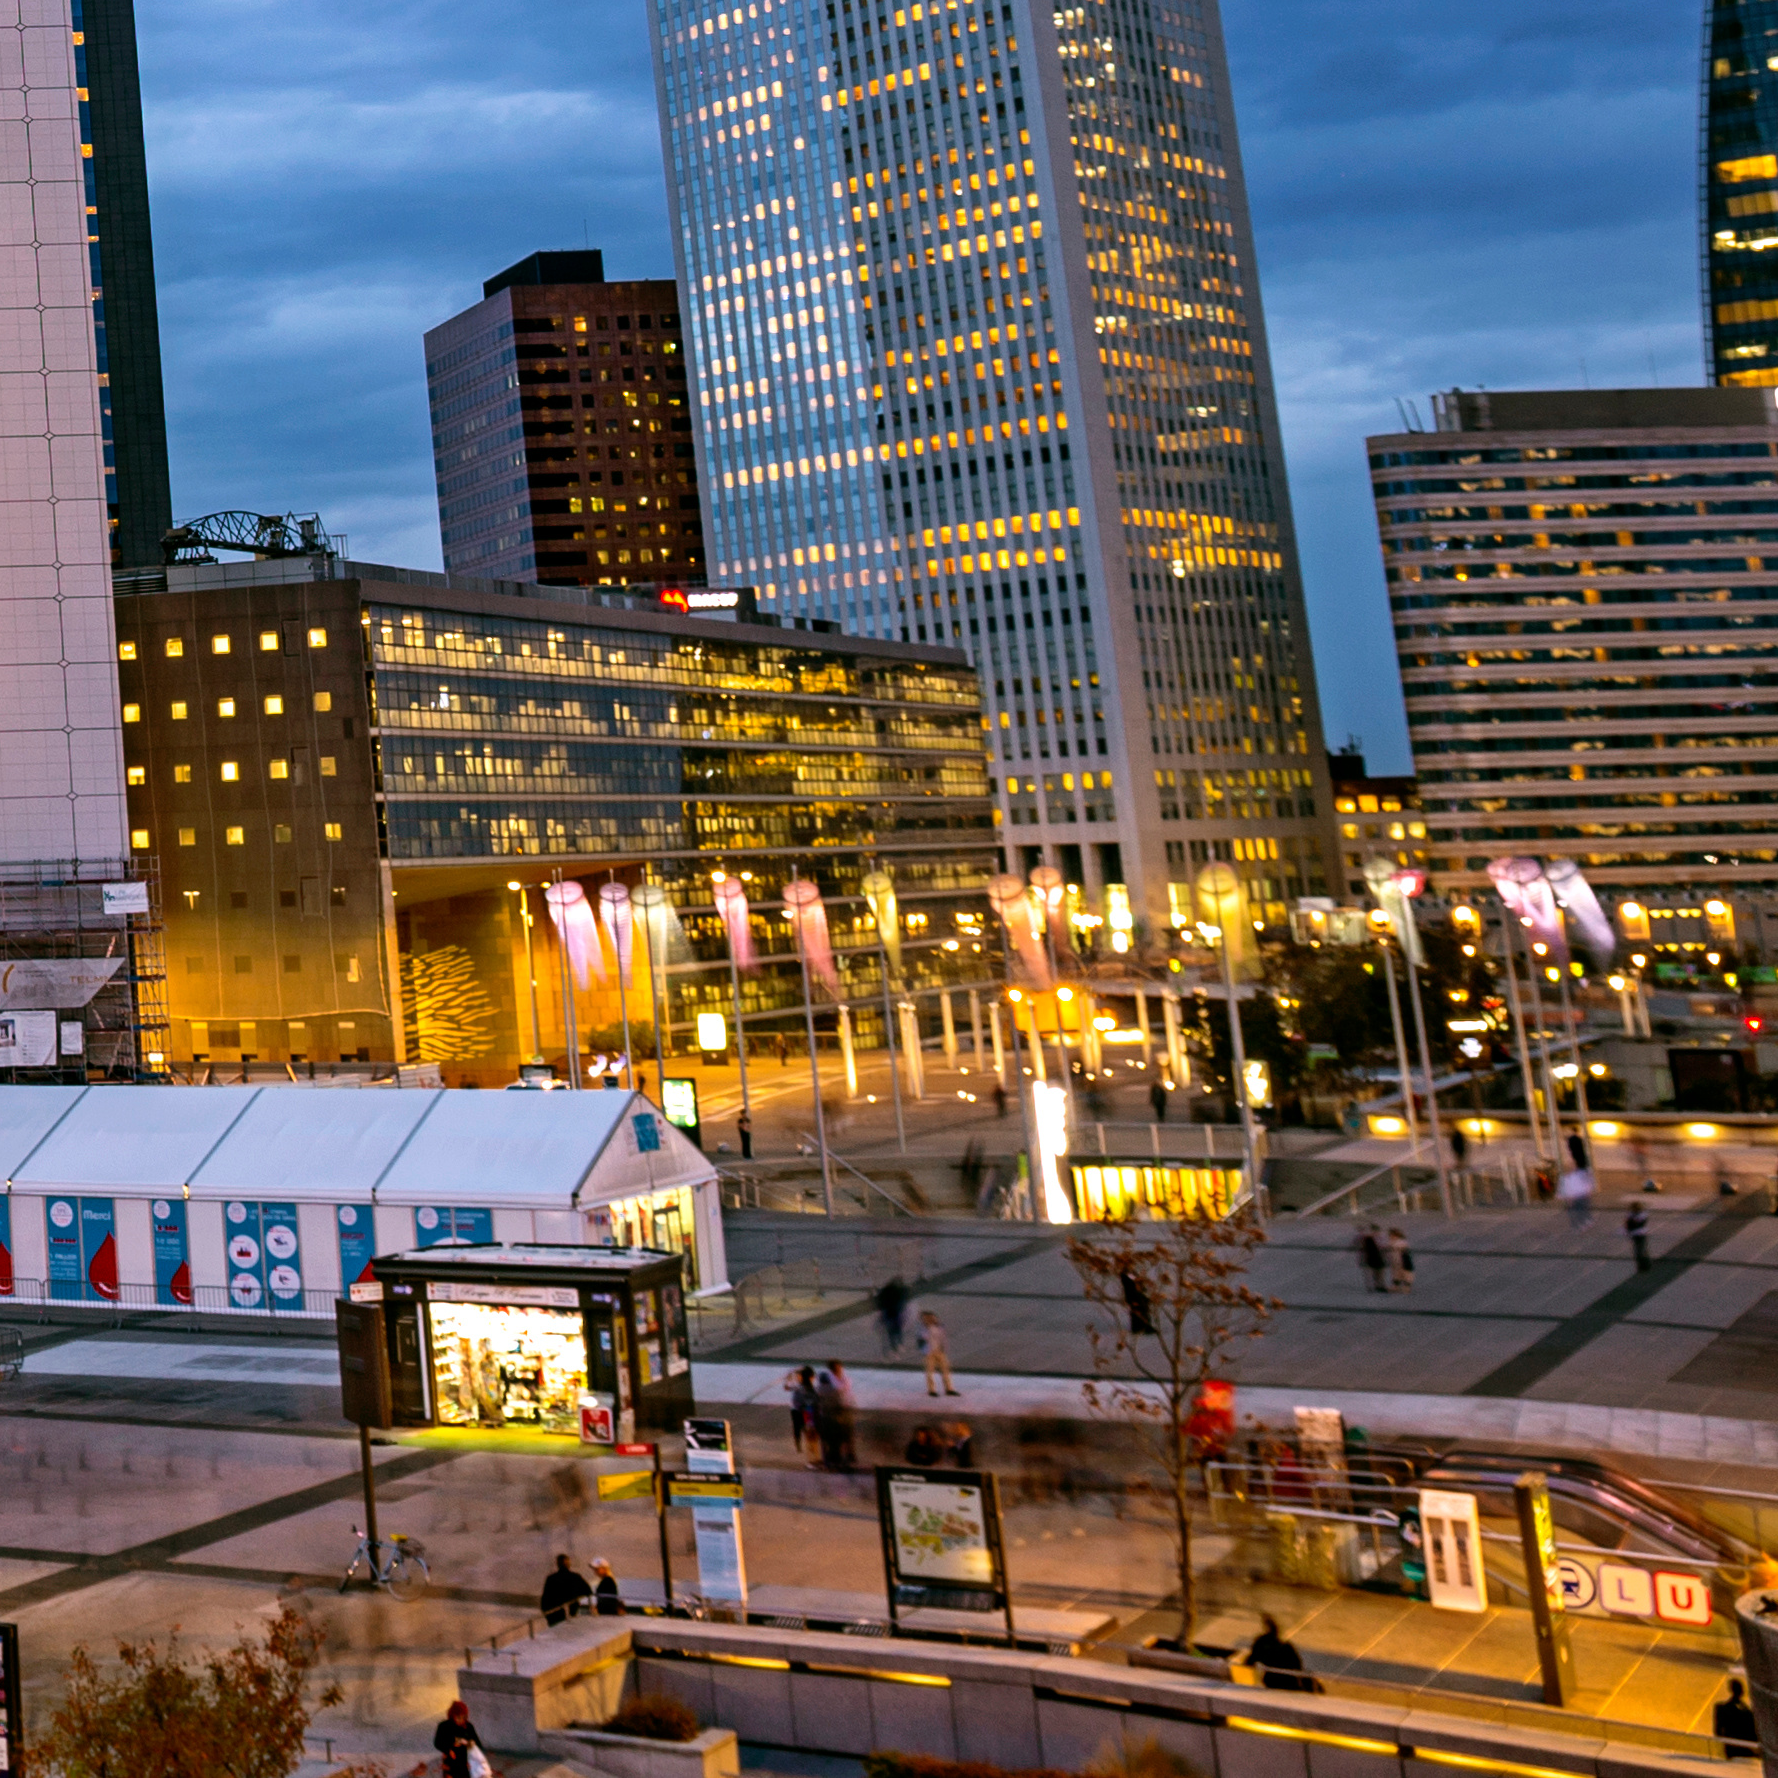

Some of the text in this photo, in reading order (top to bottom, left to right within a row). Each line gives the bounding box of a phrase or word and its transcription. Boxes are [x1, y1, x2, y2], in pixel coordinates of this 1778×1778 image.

[83, 1209, 111, 1221] Merci
[1617, 1578, 1634, 1603] L
[1670, 1584, 1694, 1610] U
